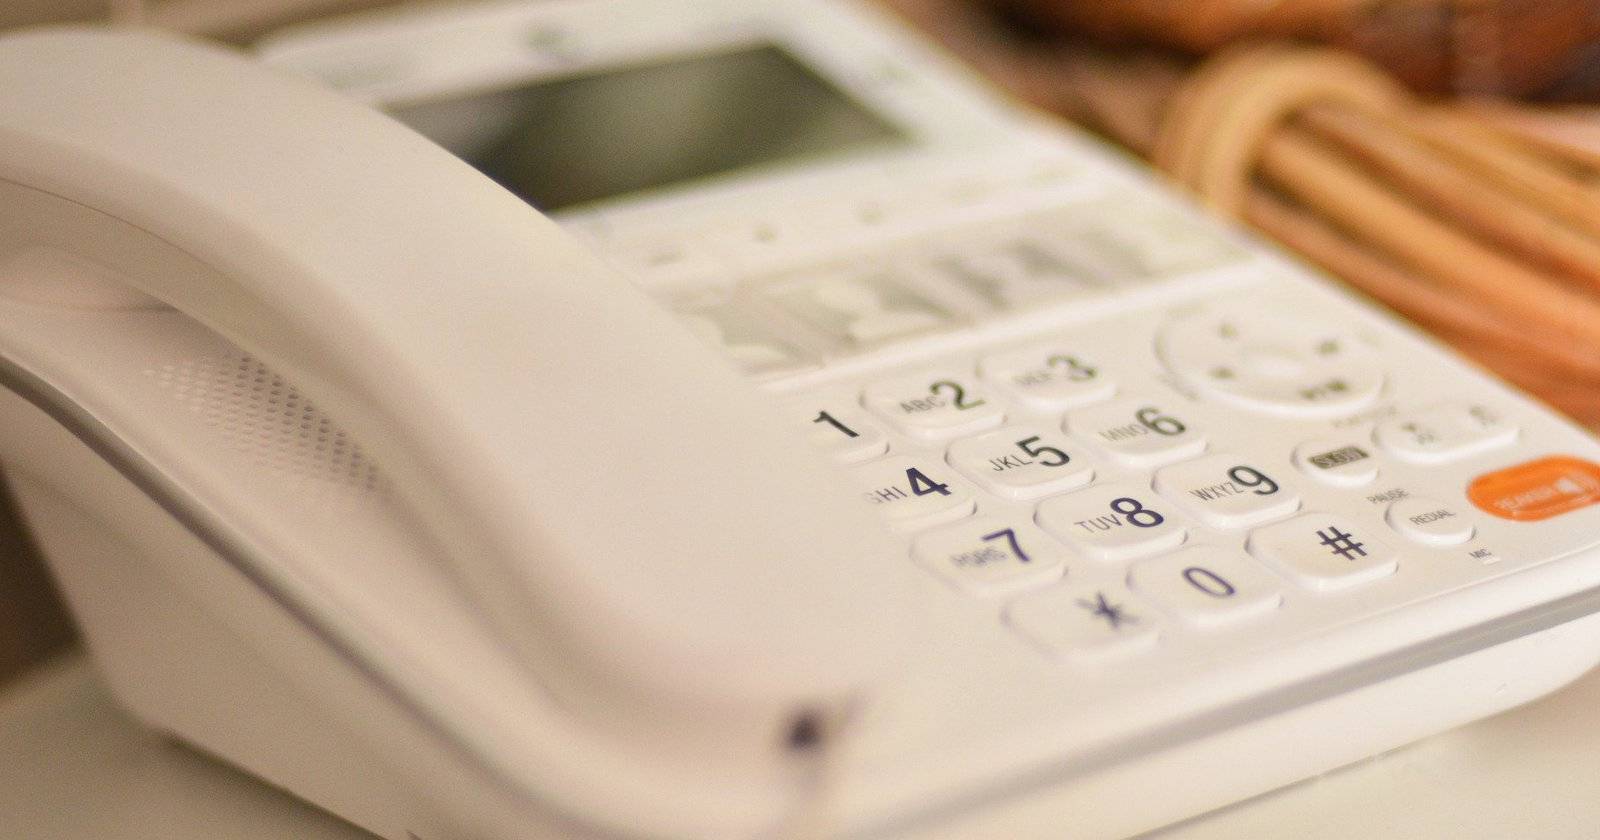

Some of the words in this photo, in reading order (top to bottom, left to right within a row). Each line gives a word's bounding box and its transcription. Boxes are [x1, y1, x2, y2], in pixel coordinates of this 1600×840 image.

[1048, 354, 1097, 381] 3
[899, 394, 948, 415] ABC
[930, 379, 986, 411] 2
[813, 410, 860, 438] 1
[1099, 422, 1150, 443] MNO
[1135, 406, 1187, 437] 6
[990, 454, 1034, 473] JKL
[1016, 436, 1071, 468] 5
[905, 467, 952, 499] 4
[1190, 481, 1244, 502] WXYZ
[1227, 464, 1280, 496] 9
[1074, 512, 1123, 534] TUV
[1109, 496, 1165, 529] 8
[1409, 507, 1457, 526] REDIAL
[981, 528, 1031, 563] 7
[1315, 526, 1369, 562] #
[1181, 566, 1237, 598] 0
